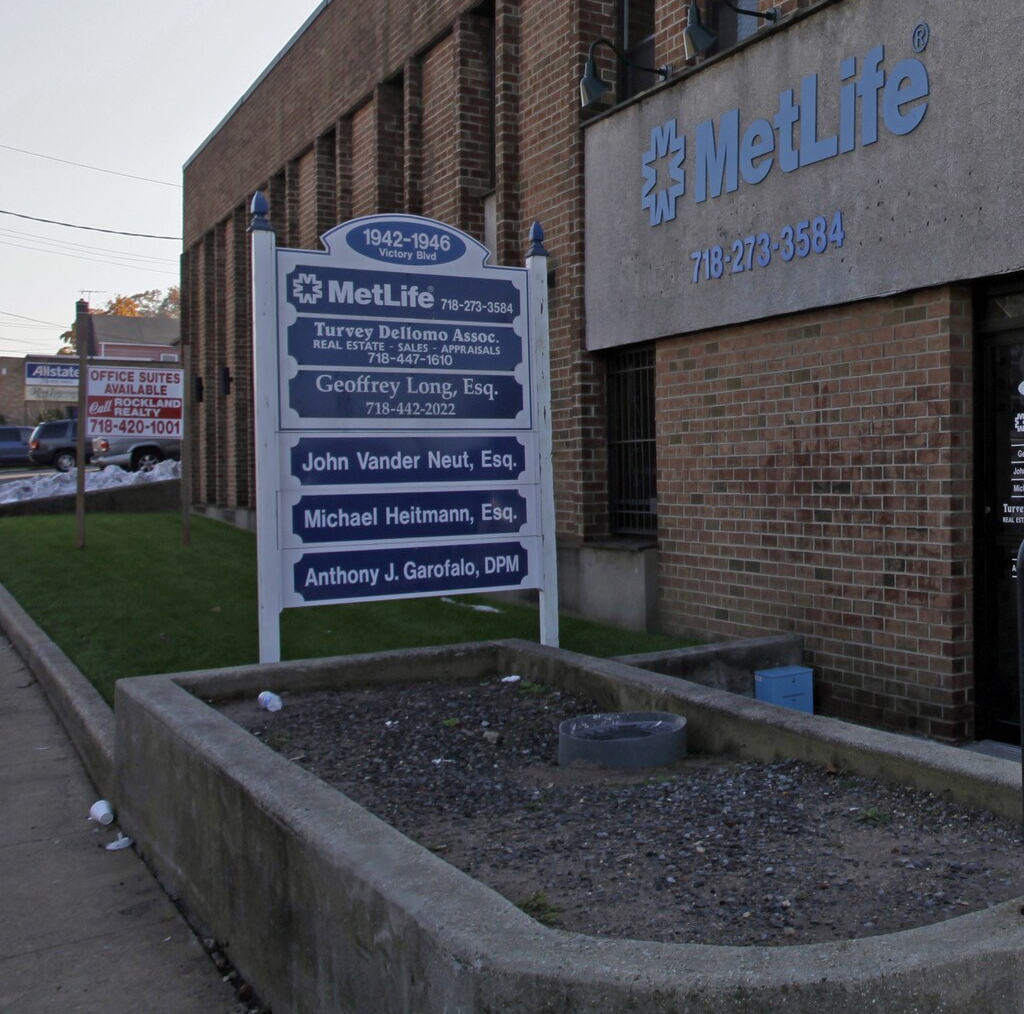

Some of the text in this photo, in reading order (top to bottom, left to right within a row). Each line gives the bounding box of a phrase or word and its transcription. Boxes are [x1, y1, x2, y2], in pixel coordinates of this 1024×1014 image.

[363, 229, 451, 252] 1942-1946
[691, 210, 846, 284] 718-273-3584
[379, 247, 437, 261] Victory Blvd
[441, 298, 514, 314] 718-273-3584
[314, 322, 500, 344] Turvey Dellomo Assoc.
[313, 339, 343, 350] REAL
[346, 341, 385, 352] ESTATE
[398, 343, 429, 353] SALES
[441, 344, 501, 356] APPRAISALS
[367, 352, 453, 366] 718-447-1610
[32, 365, 80, 378] Allstate
[90, 370, 181, 384] OFFICE SUITES
[104, 384, 168, 396] AVAILABLE
[315, 374, 499, 400] Geoffrey Long, Esq.
[89, 398, 181, 415] Call ROCKLAND
[114, 407, 161, 417] REALTY
[365, 401, 456, 416] 718-442-2022
[90, 419, 180, 435] 718-420-1001
[302, 450, 518, 472] John Vander Neut, Esq.
[304, 503, 518, 528] Michael Heitmann, Esq.
[304, 554, 520, 588] Anthony J. Garofalo, DPM
